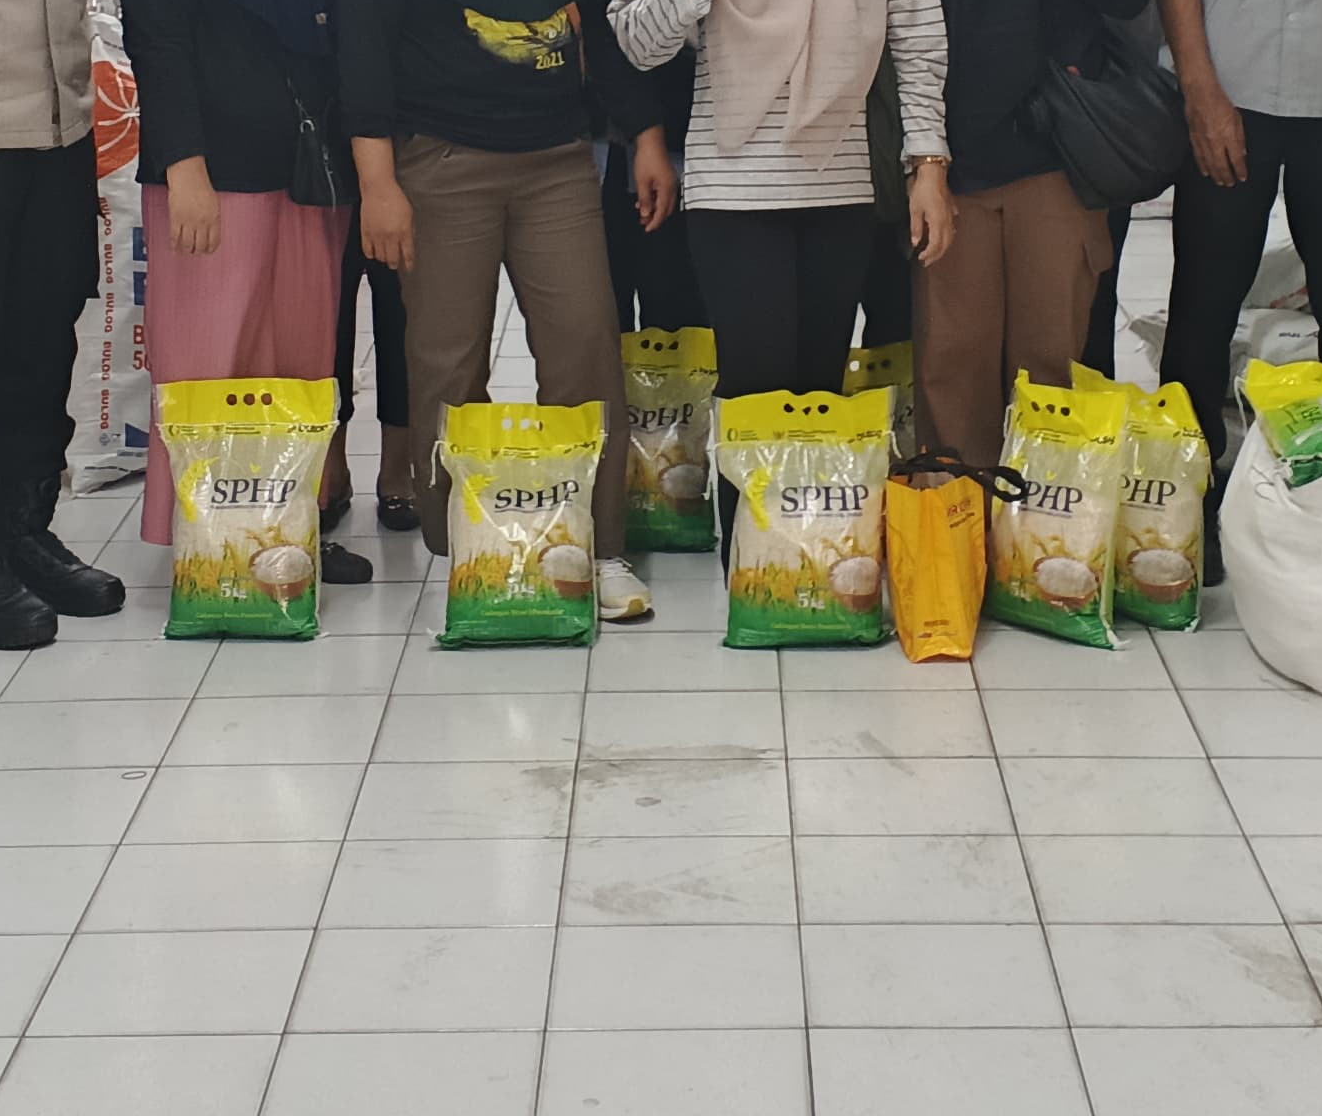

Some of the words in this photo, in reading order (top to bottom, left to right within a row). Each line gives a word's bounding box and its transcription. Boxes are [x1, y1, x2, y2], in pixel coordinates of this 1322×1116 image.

[535, 51, 565, 70] 2021
[103, 243, 114, 284] BULOG
[104, 292, 114, 333] BULOG
[101, 341, 112, 381] BULOG
[100, 389, 110, 430] BULOG
[210, 477, 297, 504] SPHP
[494, 479, 580, 509] SPHP
[780, 484, 869, 513] SPHP
[1021, 481, 1083, 513] PHP
[797, 592, 809, 608] 5
